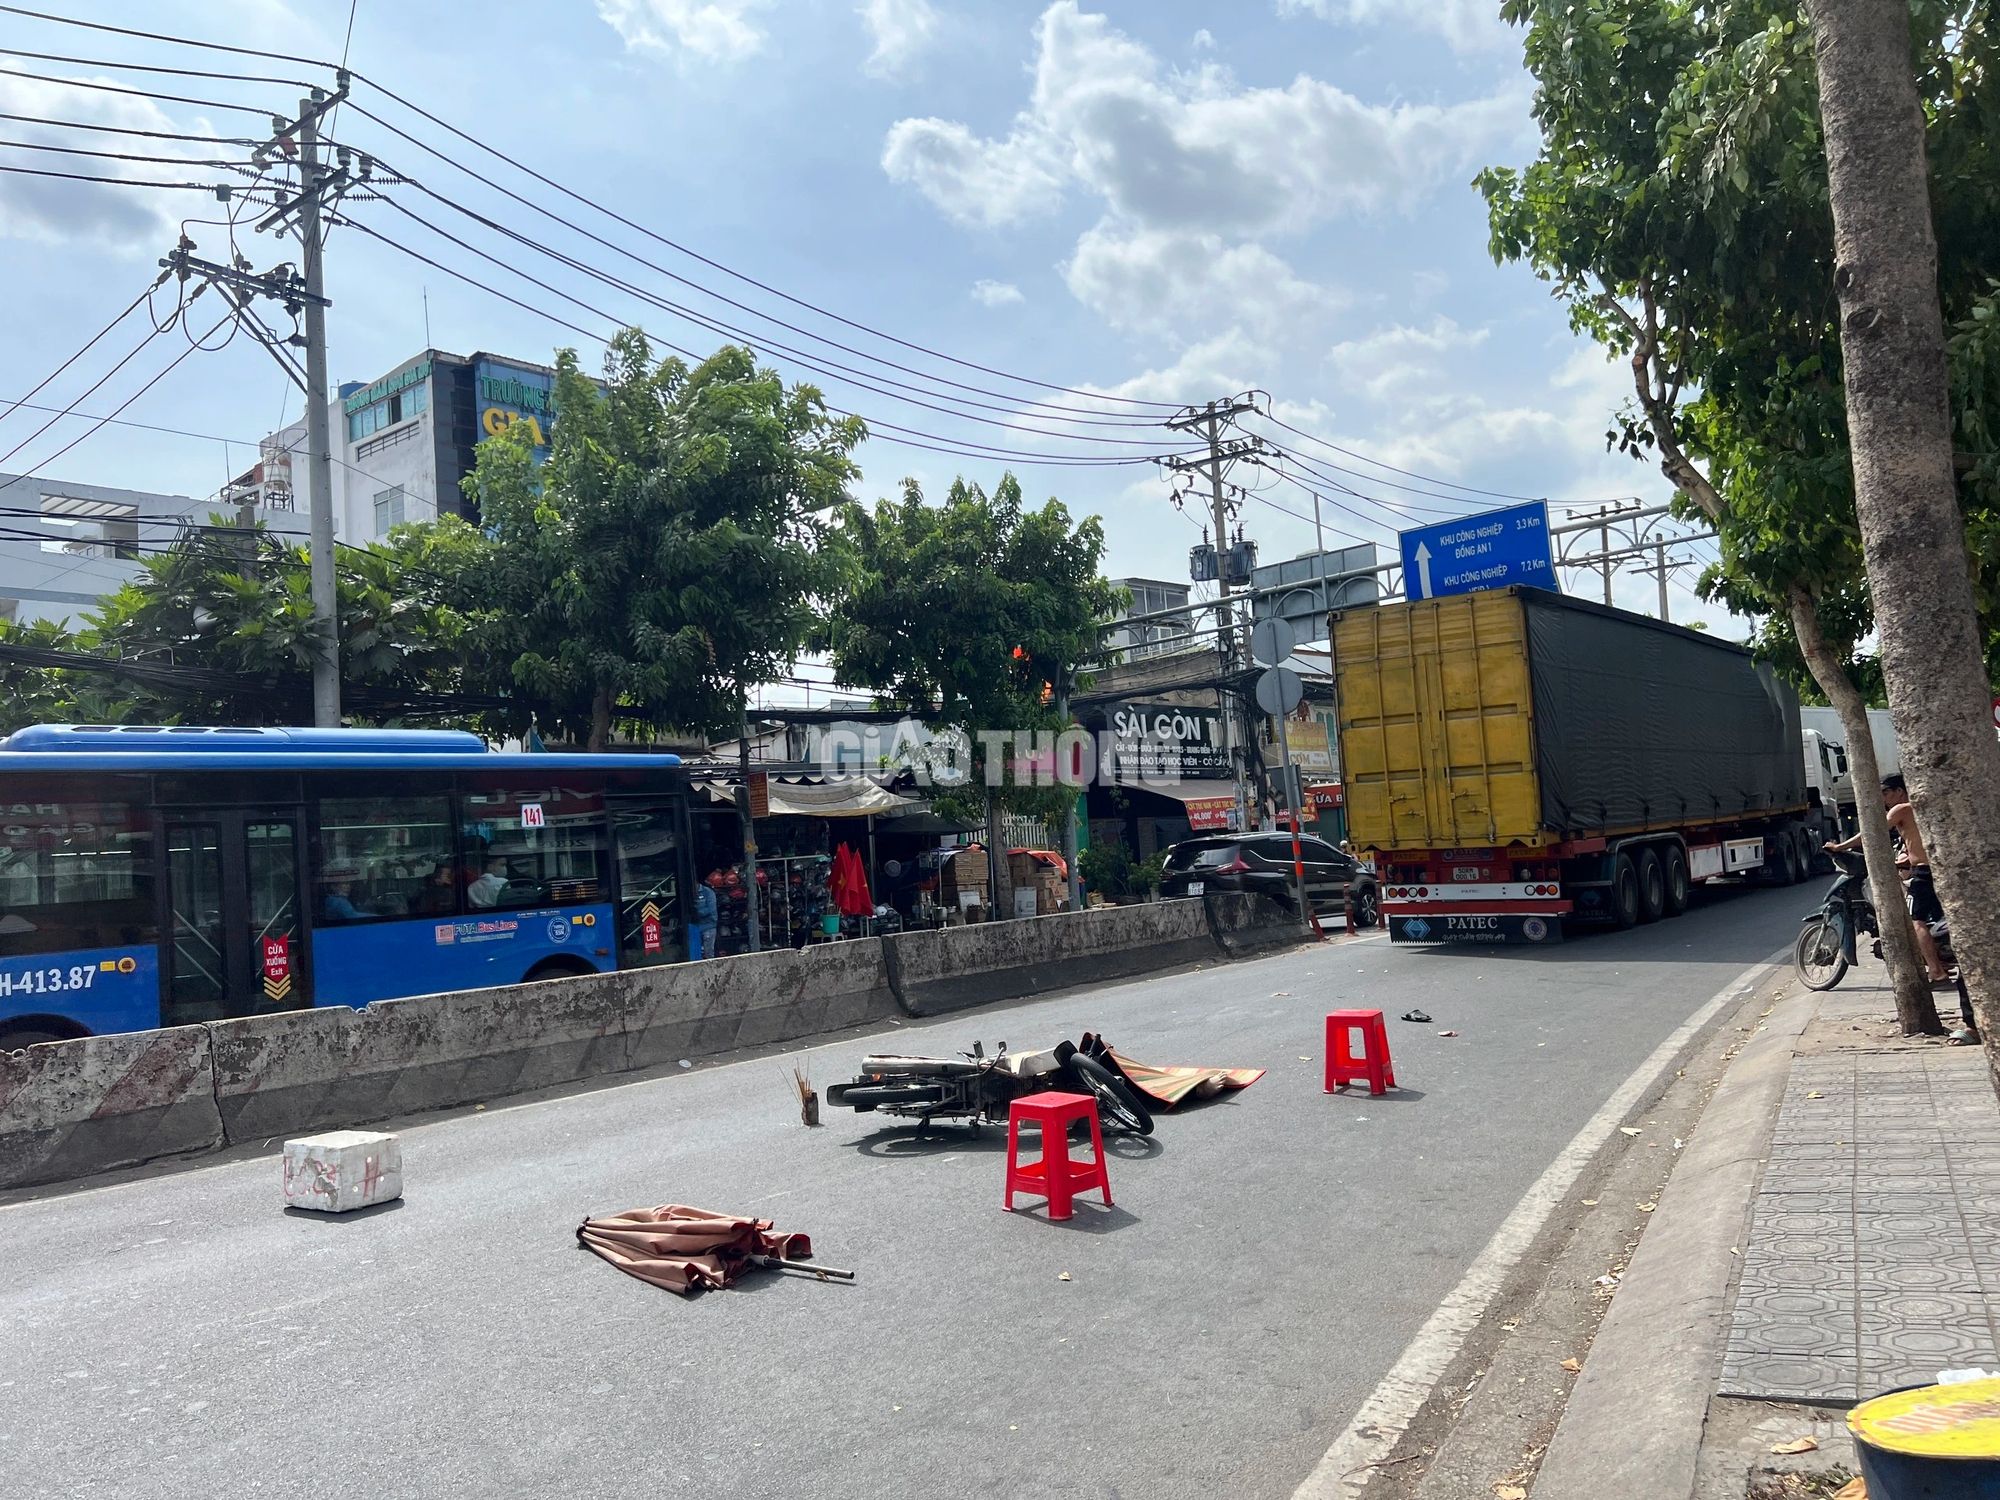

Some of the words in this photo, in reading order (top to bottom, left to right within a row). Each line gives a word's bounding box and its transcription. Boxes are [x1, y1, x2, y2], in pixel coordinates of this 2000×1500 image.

[481, 376, 544, 410] TRƯỜNG
[1440, 534, 1455, 546] KHU
[1456, 529, 1475, 542] CÔNG
[1477, 522, 1503, 537] NGHIỆP
[1528, 517, 1540, 528] Km
[1455, 544, 1475, 558] ĐỒNG
[1477, 543, 1487, 554] AN
[1444, 575, 1459, 586] KHU
[1461, 569, 1480, 583] CÔNG
[1482, 564, 1508, 578] NGHIỆP
[1533, 559, 1545, 569] Km
[1114, 705, 1148, 738] SÀI
[1154, 708, 1201, 740] GÒN
[1120, 756, 1138, 768] NHẬN
[1140, 755, 1153, 766] ĐÀO
[1154, 756, 1167, 768] TẠO
[1168, 756, 1182, 768] HỌC
[1183, 755, 1198, 766] VIÊN
[523, 808, 542, 825] 141
[454, 923, 476, 935] FUTA
[478, 922, 494, 932] Bus
[495, 920, 518, 932] Lines
[1447, 917, 1498, 929] PATEC
[268, 943, 283, 955] CỬA
[266, 955, 286, 966] XUỐNG
